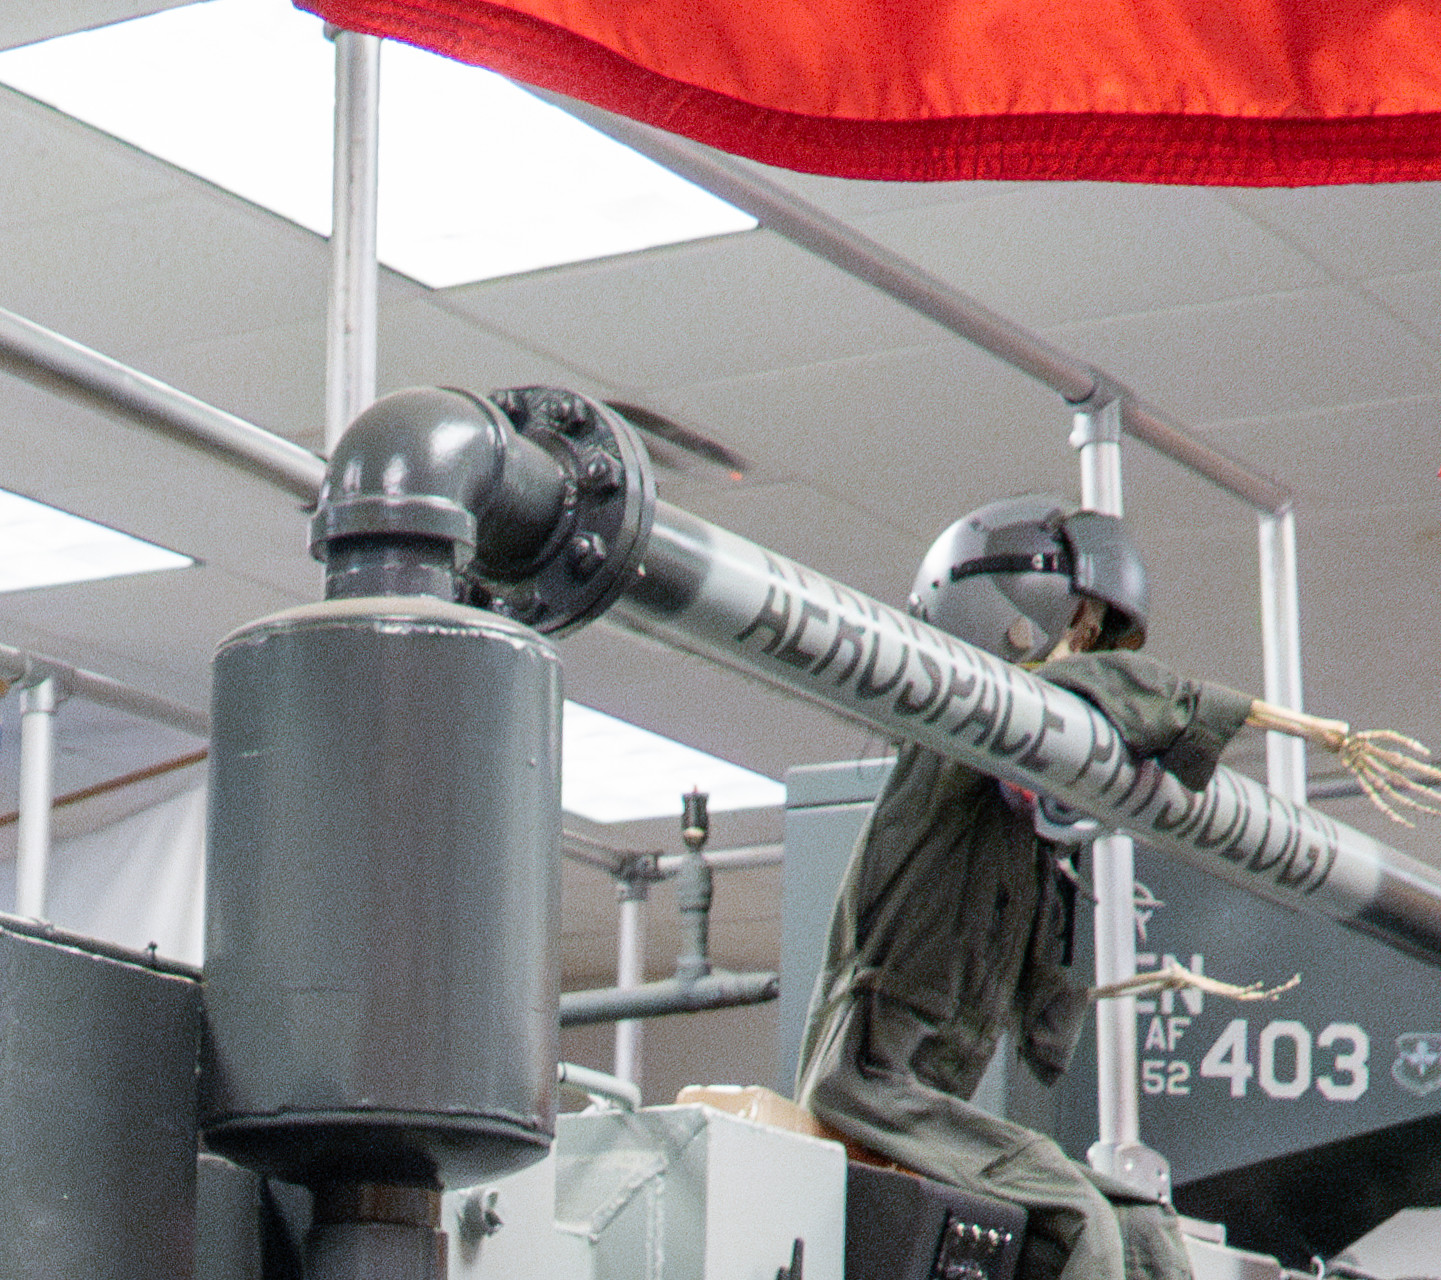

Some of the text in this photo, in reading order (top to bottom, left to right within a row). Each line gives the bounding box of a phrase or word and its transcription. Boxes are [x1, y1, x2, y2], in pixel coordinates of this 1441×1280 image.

[735, 554, 1065, 774] AEROSPACE
[1144, 1016, 1192, 1052] AF
[1199, 1018, 1371, 1102] 403
[1141, 1060, 1191, 1096] 52
